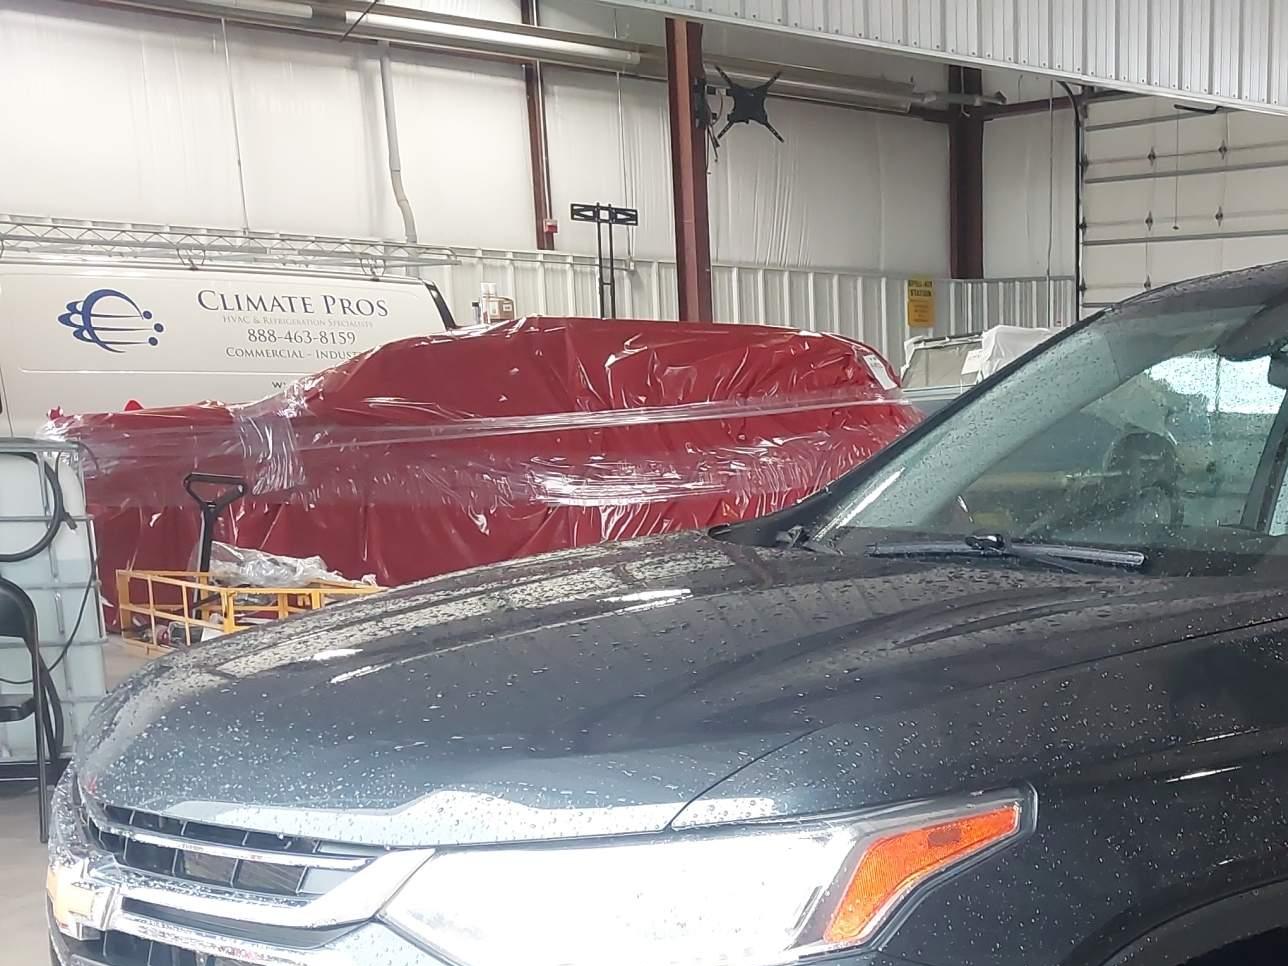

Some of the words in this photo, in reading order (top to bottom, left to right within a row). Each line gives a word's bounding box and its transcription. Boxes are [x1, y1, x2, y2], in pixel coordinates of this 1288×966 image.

[197, 289, 315, 314] CLIMATE
[321, 294, 390, 318] PROS
[222, 315, 249, 325] HVAC
[262, 316, 327, 328] REFRIGERATION
[247, 328, 356, 345] 888-463-8159
[225, 346, 305, 360] COMMERCIAL
[315, 349, 361, 361] INDUST
